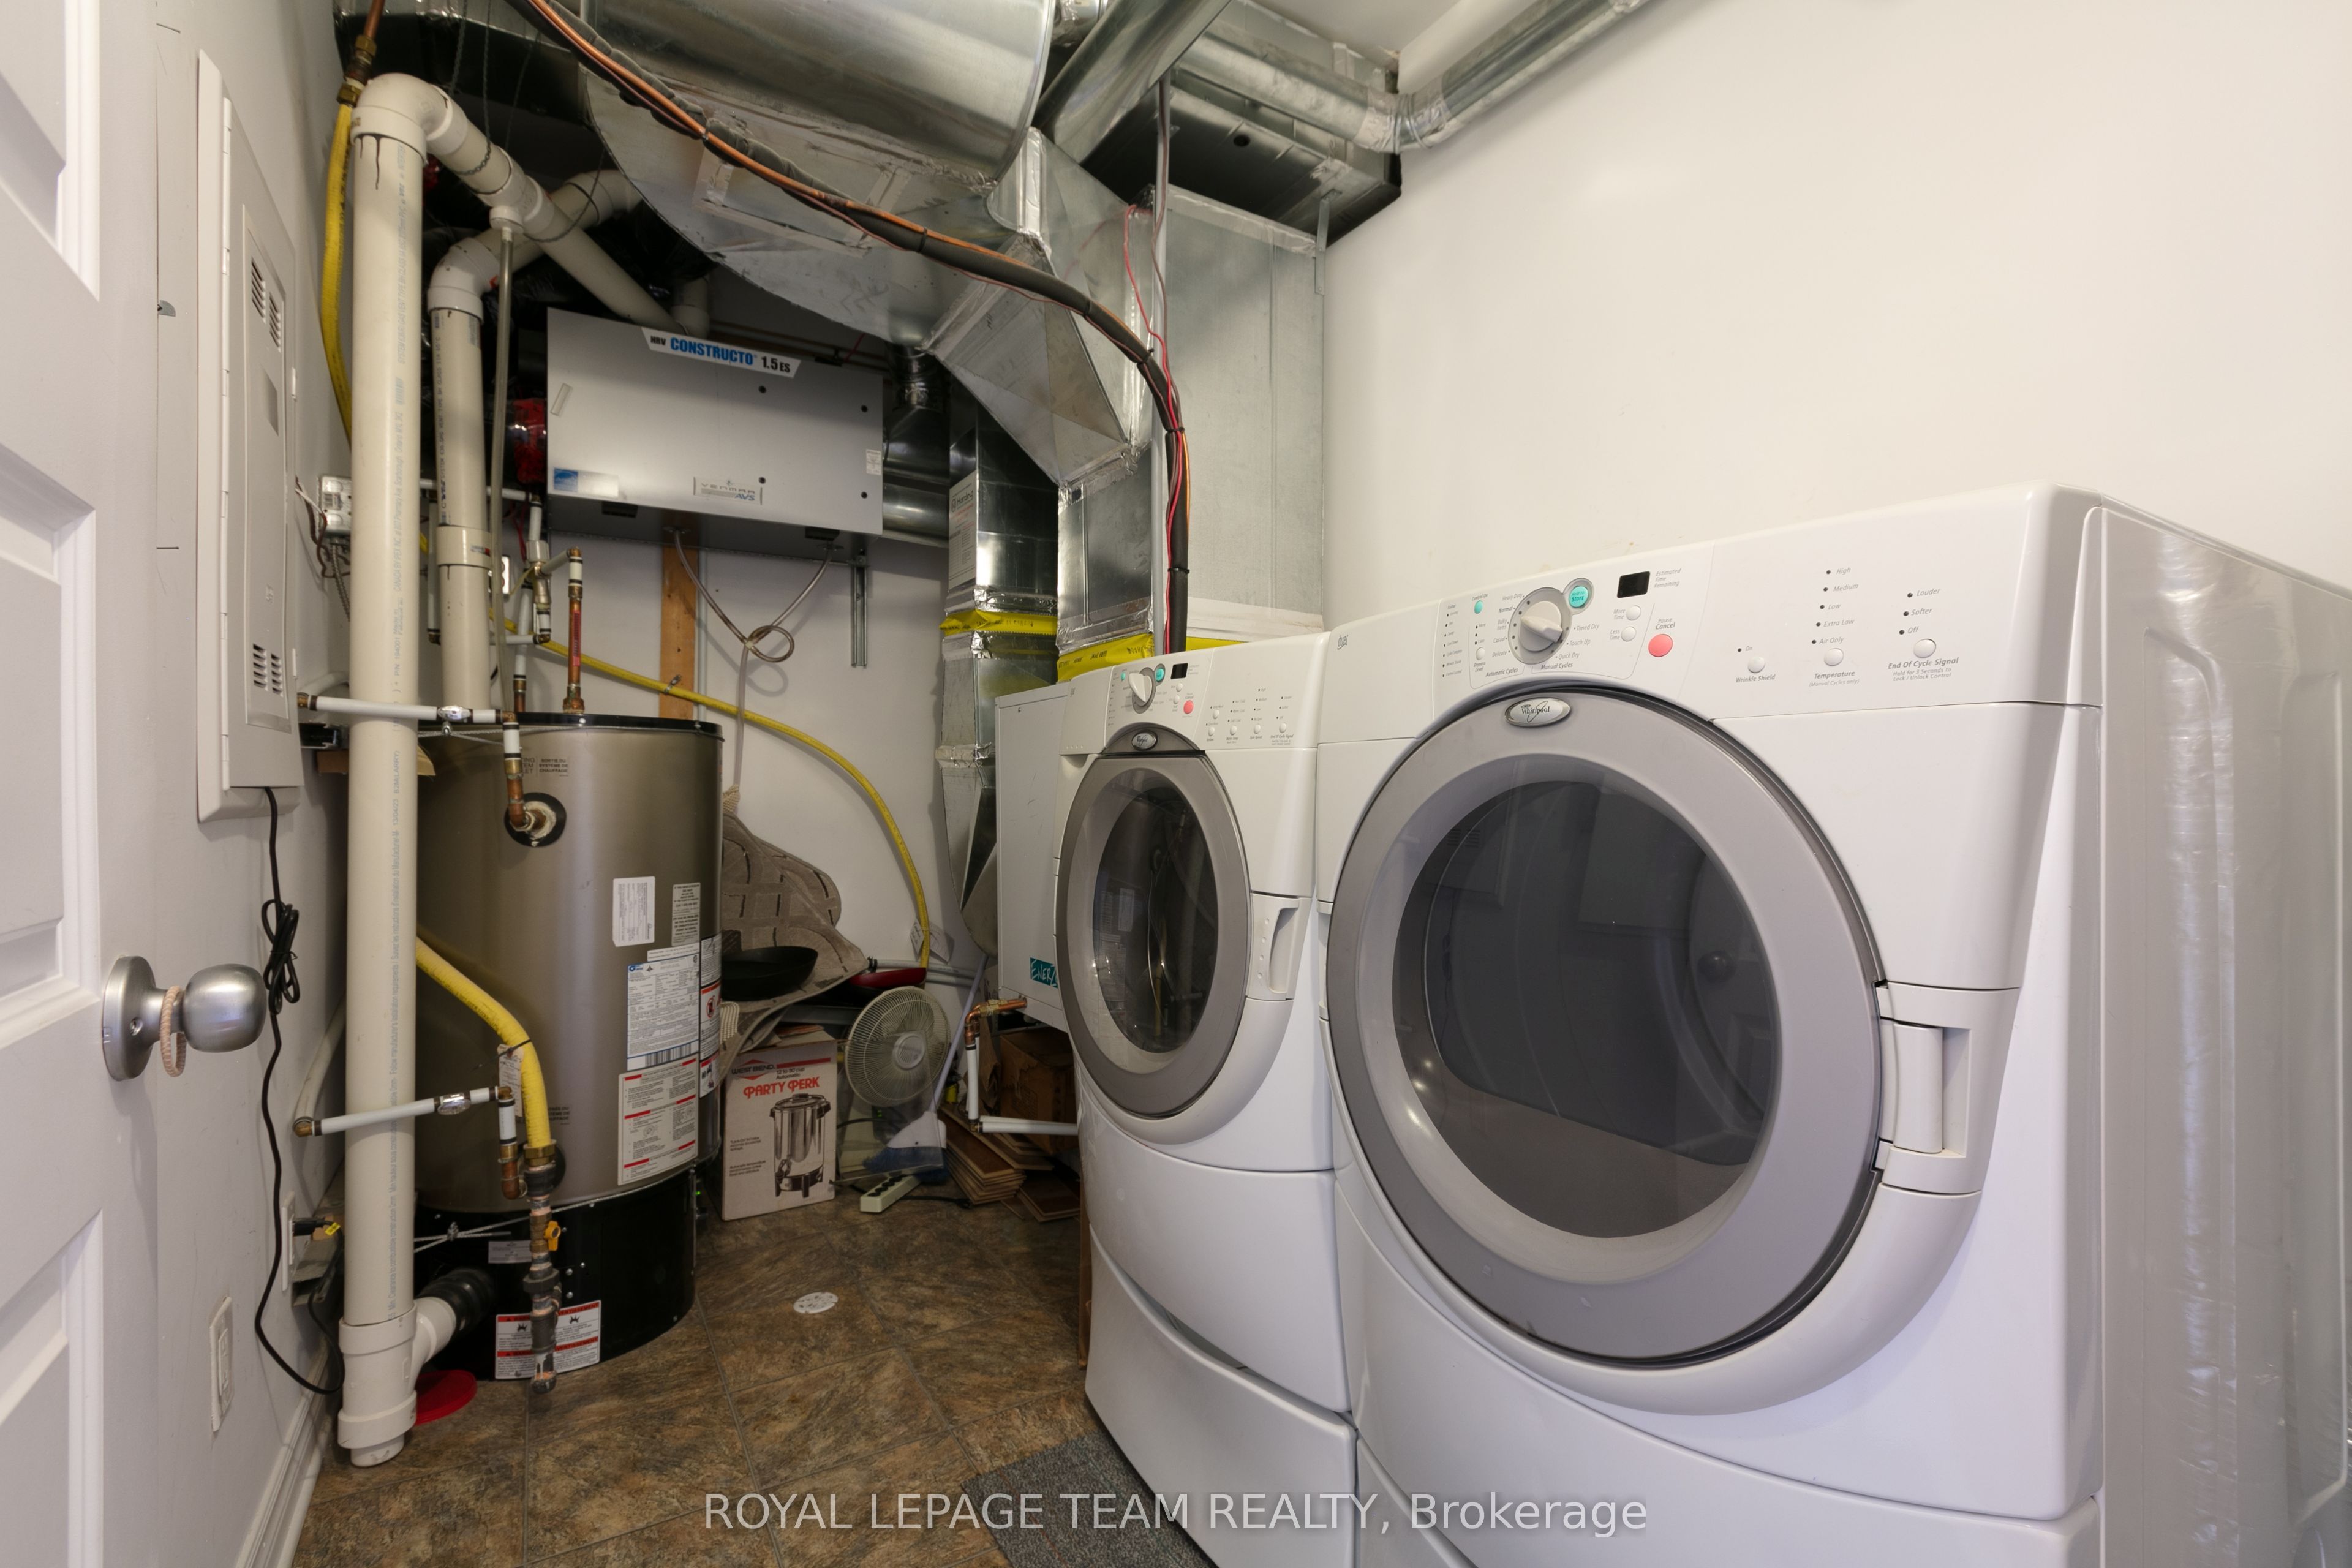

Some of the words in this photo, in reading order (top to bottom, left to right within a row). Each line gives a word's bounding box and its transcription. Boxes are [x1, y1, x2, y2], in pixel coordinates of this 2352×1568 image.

[650, 336, 666, 346] HRV
[670, 337, 754, 366] CONSTRUCTO
[761, 355, 778, 371] 1.5
[780, 362, 791, 373] ES
[1913, 660, 1932, 668] Cycle
[1934, 657, 1959, 666] Signal
[1485, 669, 1506, 677] Automatic
[1814, 671, 1855, 680] Temperature
[1521, 706, 1550, 715] Whirlpool
[743, 1081, 786, 1099] PARTY
[788, 1076, 820, 1093] PERK
